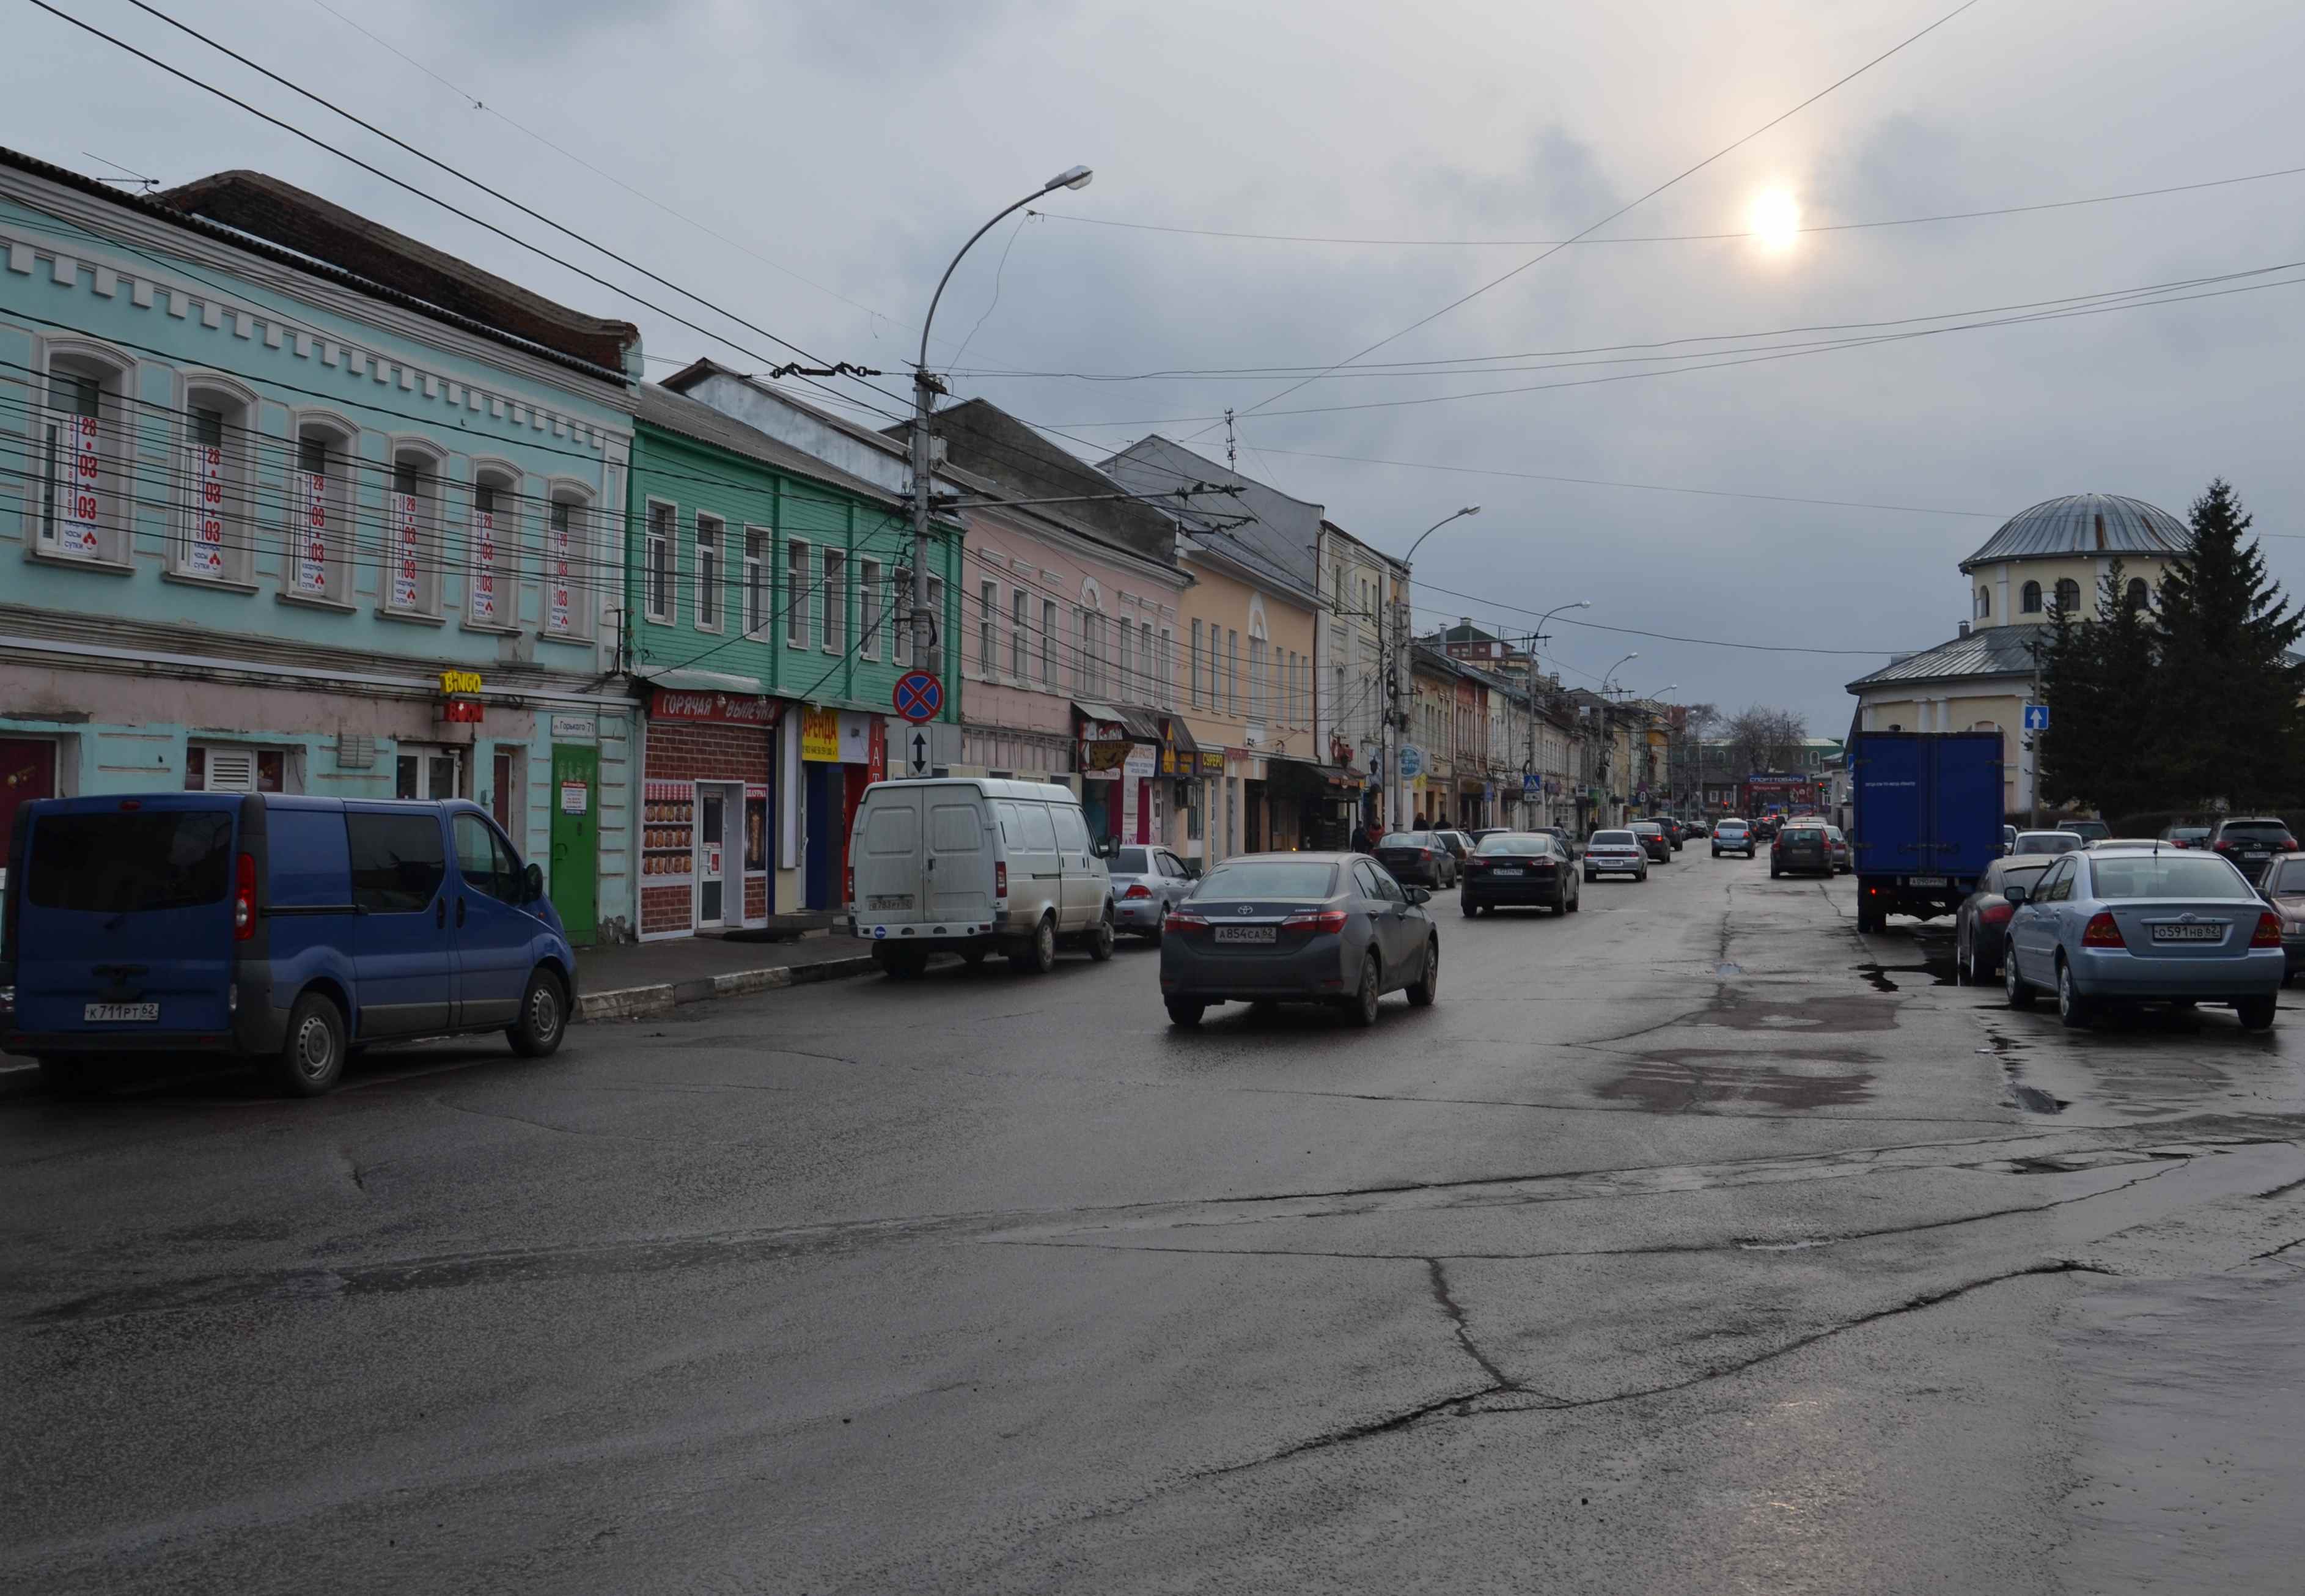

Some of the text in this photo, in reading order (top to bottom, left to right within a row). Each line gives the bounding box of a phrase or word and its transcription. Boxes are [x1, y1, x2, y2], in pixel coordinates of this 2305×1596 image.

[82, 417, 97, 436] 28
[80, 455, 97, 478] 03
[208, 448, 220, 465] 28
[314, 476, 323, 491] 28
[79, 496, 96, 520] 03
[406, 497, 416, 512] 28
[205, 521, 220, 542] 03
[663, 694, 775, 720] ГОРЯЧАЯ ВЫПЕЧКА
[560, 721, 585, 730] Горького
[587, 723, 595, 732] 71
[803, 713, 837, 745] АРЕНДА
